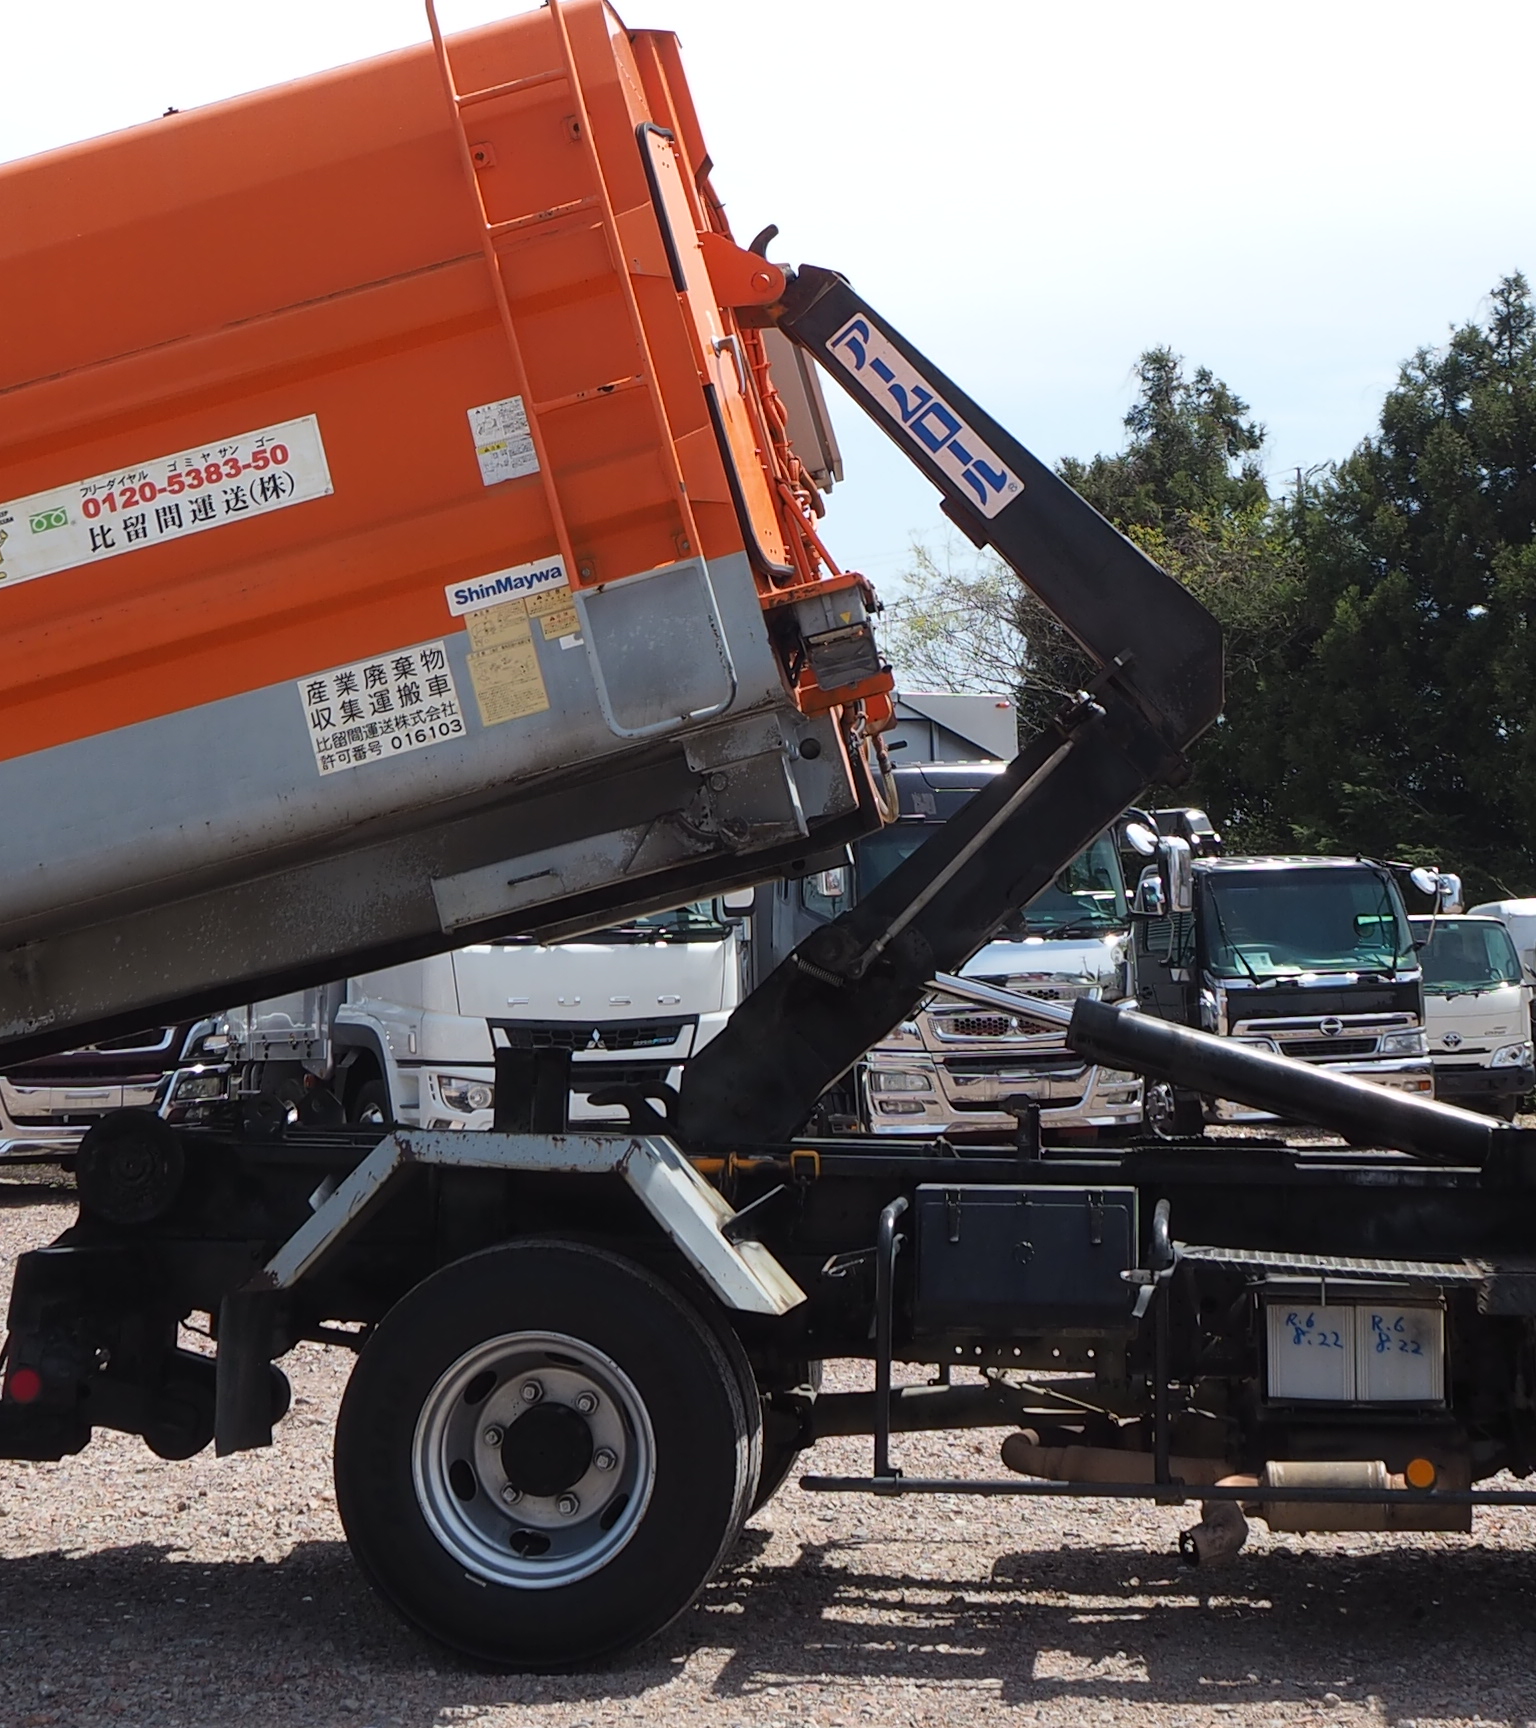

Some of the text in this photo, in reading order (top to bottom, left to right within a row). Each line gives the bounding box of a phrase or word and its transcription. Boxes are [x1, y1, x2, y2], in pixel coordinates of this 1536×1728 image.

[80, 470, 149, 498] フリーダイヤル
[81, 443, 290, 520] 0120-5383-50
[454, 565, 563, 606] ShinMaywa
[306, 649, 446, 707] 産業廃棄物
[310, 673, 452, 732] 収集運搬車
[315, 700, 458, 754] 比留間運送株式会社
[320, 719, 463, 770] 許可番号 016103
[507, 994, 681, 1008] FUSO
